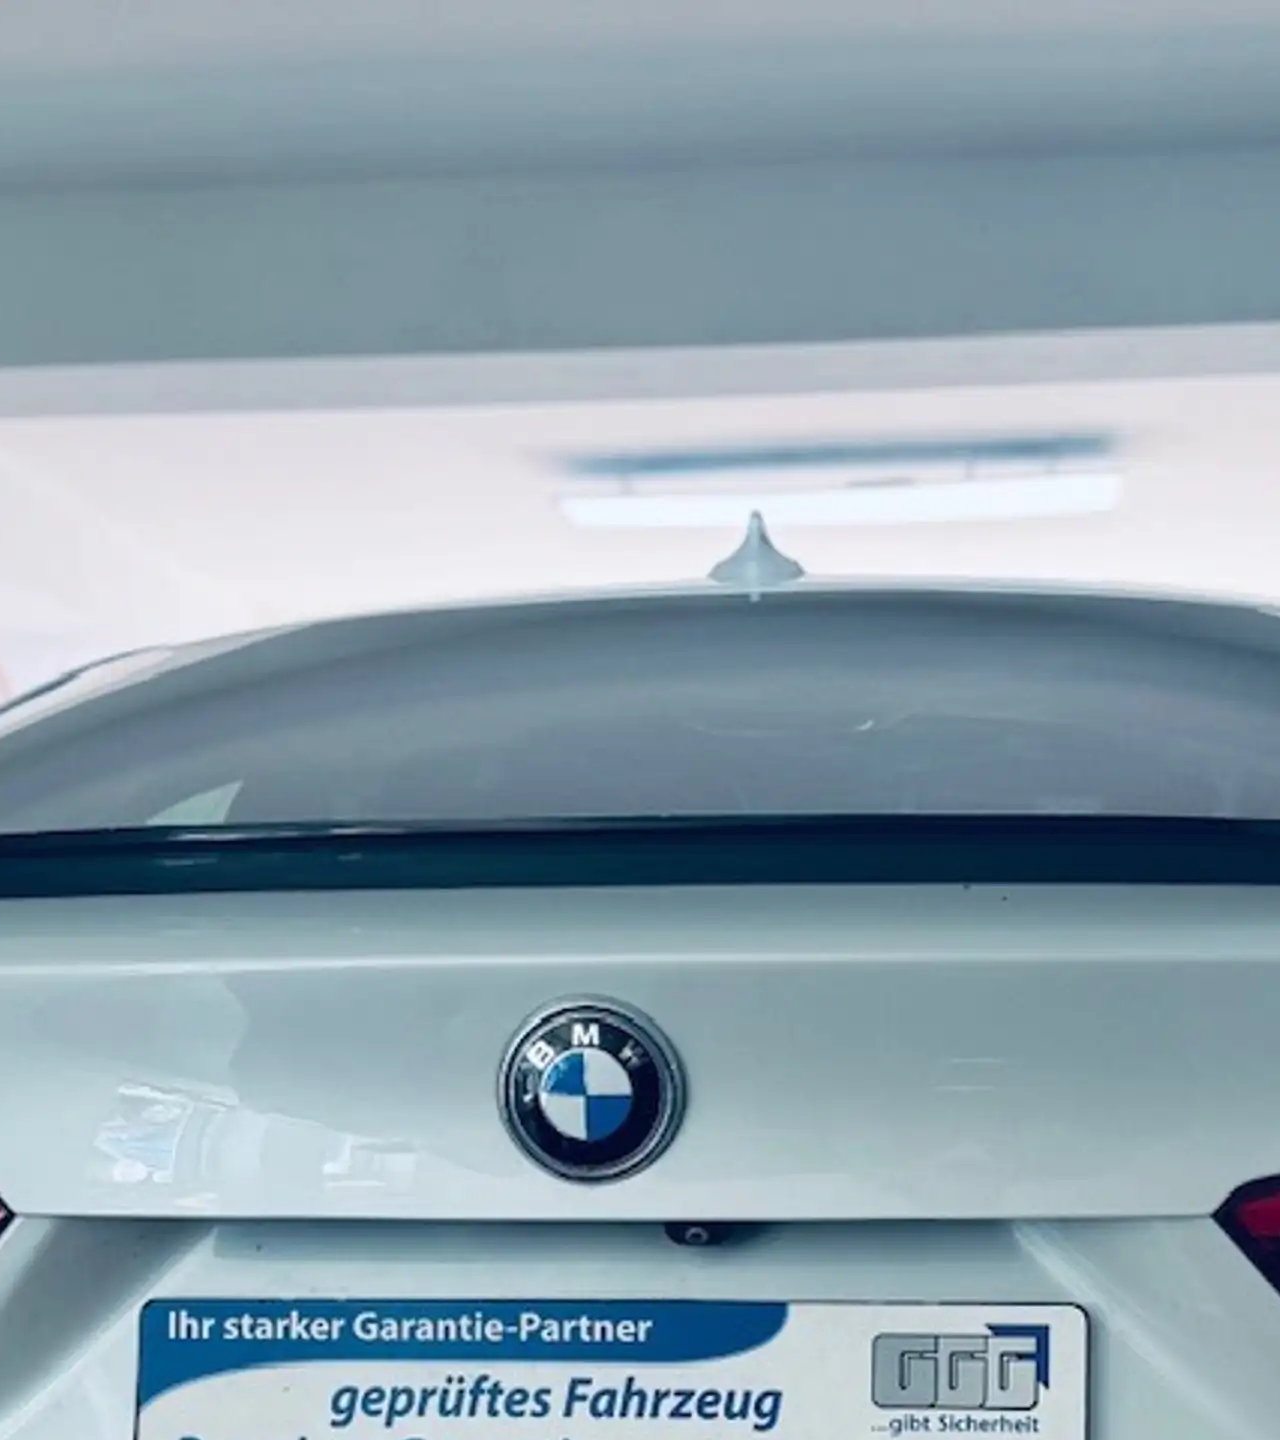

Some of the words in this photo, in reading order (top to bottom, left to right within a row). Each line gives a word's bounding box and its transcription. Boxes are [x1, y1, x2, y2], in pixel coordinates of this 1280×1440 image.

[168, 1309, 216, 1341] Ihr
[222, 1309, 346, 1341] starker
[352, 1310, 654, 1343] Garantie-Partner
[329, 1373, 553, 1429] geprüftes
[562, 1375, 784, 1432] Fahrzeug
[937, 1413, 1040, 1434] Sicherheit
